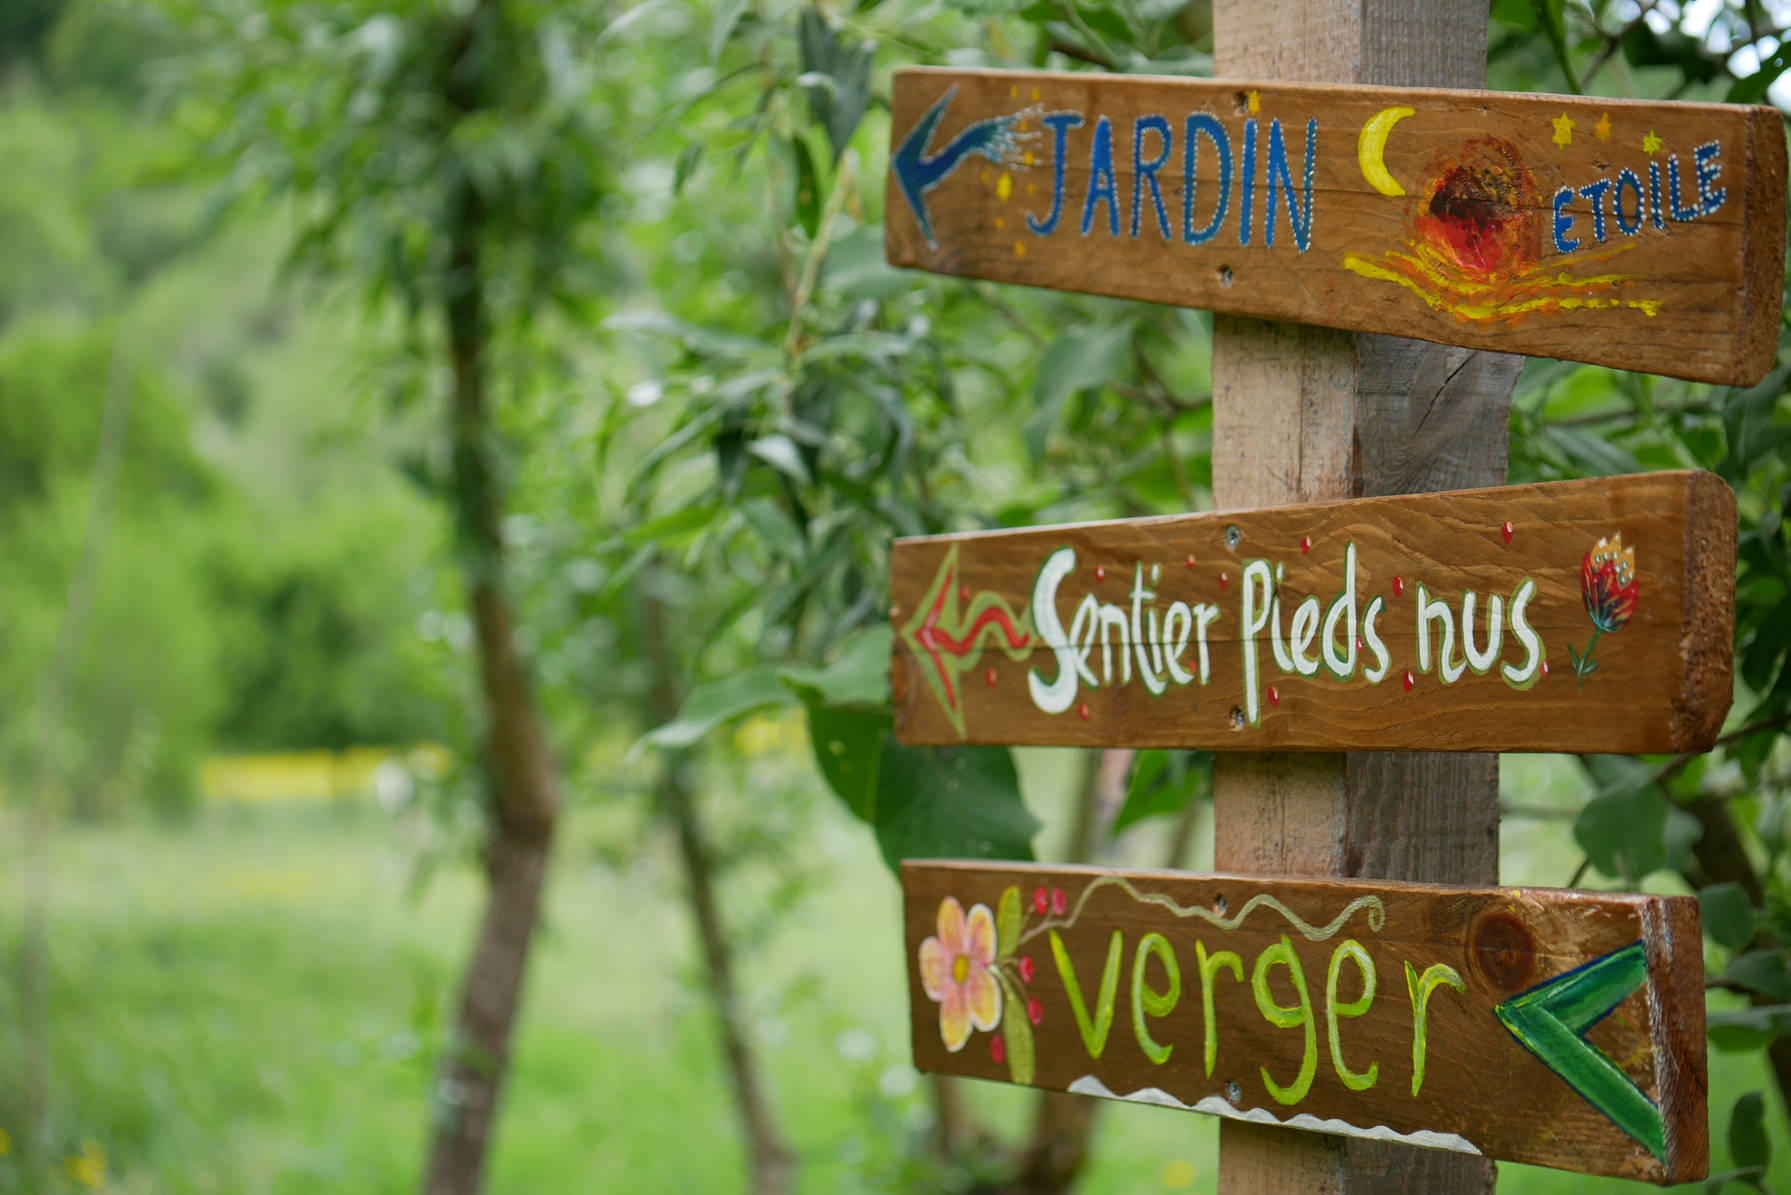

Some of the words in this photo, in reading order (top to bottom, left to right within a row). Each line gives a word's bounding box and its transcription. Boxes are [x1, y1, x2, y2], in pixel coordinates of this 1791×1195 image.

[1025, 109, 1318, 254] JARDIN
[1551, 139, 1727, 254] ETOILE
[1028, 544, 1220, 714] Sentier
[1241, 541, 1391, 728] Pieds
[1416, 576, 1547, 691] nus
[1049, 929, 1467, 1105] verger
